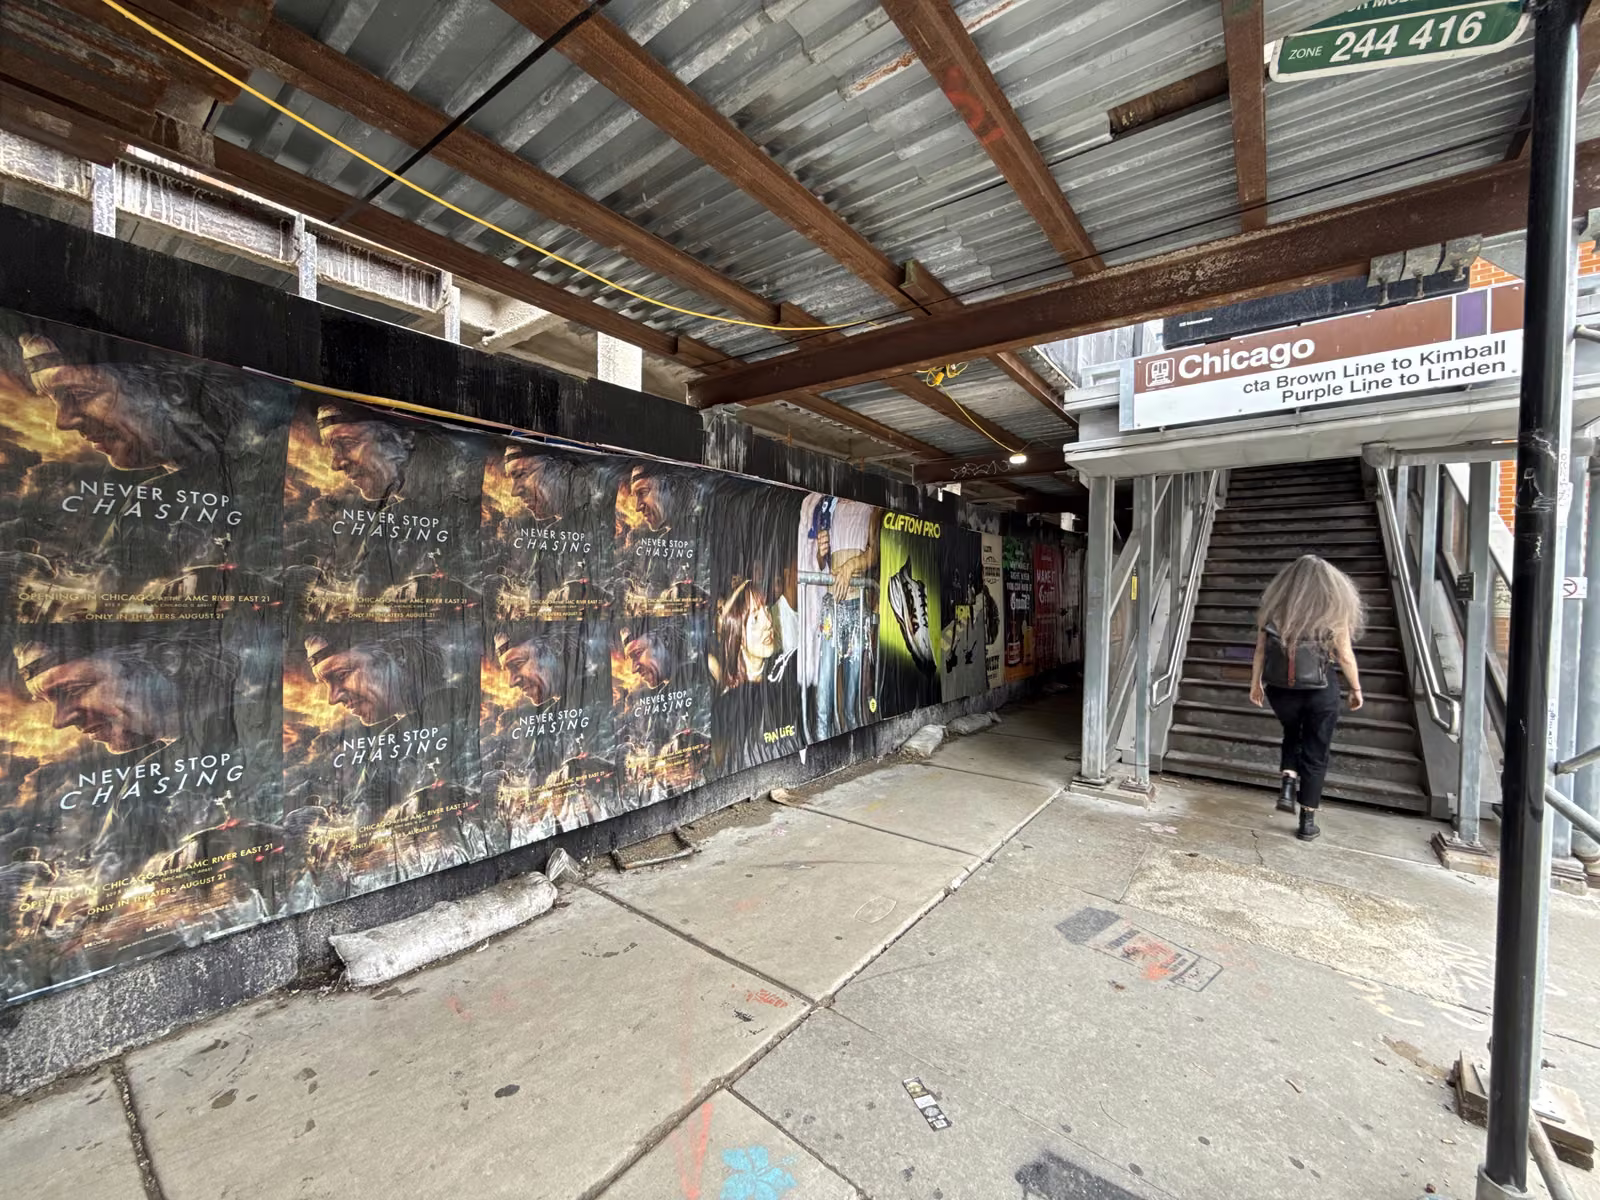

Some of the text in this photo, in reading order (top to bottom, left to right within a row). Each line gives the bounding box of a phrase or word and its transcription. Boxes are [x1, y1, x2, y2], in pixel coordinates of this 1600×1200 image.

[1287, 11, 1487, 63] ZONE 244 416
[1178, 338, 1315, 379] Chicago
[1243, 340, 1506, 394] cta Brown Line to Kimball
[1282, 361, 1506, 403] Purple Line to Linden
[80, 480, 230, 507] NEVER STOP
[61, 495, 243, 526] CHASING
[343, 508, 440, 528] NEVER STOP
[332, 520, 449, 543] CHASING
[520, 527, 585, 542] NEVER STOP
[883, 511, 941, 538] CLIFTON PRO
[513, 537, 591, 553] CHASING
[636, 545, 694, 559] CHASING
[641, 537, 689, 549] NEVER STOP
[101, 593, 155, 601] CHICAGO
[185, 594, 209, 602] AMC
[634, 697, 692, 718] CHASING
[639, 690, 687, 706] NEVER STOP
[511, 716, 589, 740] CHASING
[519, 708, 583, 726] NEVER STOP
[343, 727, 439, 751] NEVER STOP
[763, 728, 779, 743] FAN
[333, 737, 448, 768] CHASING
[78, 753, 231, 788] NEVER STOP
[59, 765, 244, 810] CHASING
[102, 872, 155, 891] CHICAGO
[185, 859, 209, 870] AMC
[212, 851, 238, 864] RIVER
[240, 845, 262, 857] EAST
[264, 843, 273, 852] 21
[87, 903, 115, 915] ONLY
[117, 899, 129, 907] IN
[133, 886, 177, 903] THEATERS
[180, 876, 215, 890] AUGUST
